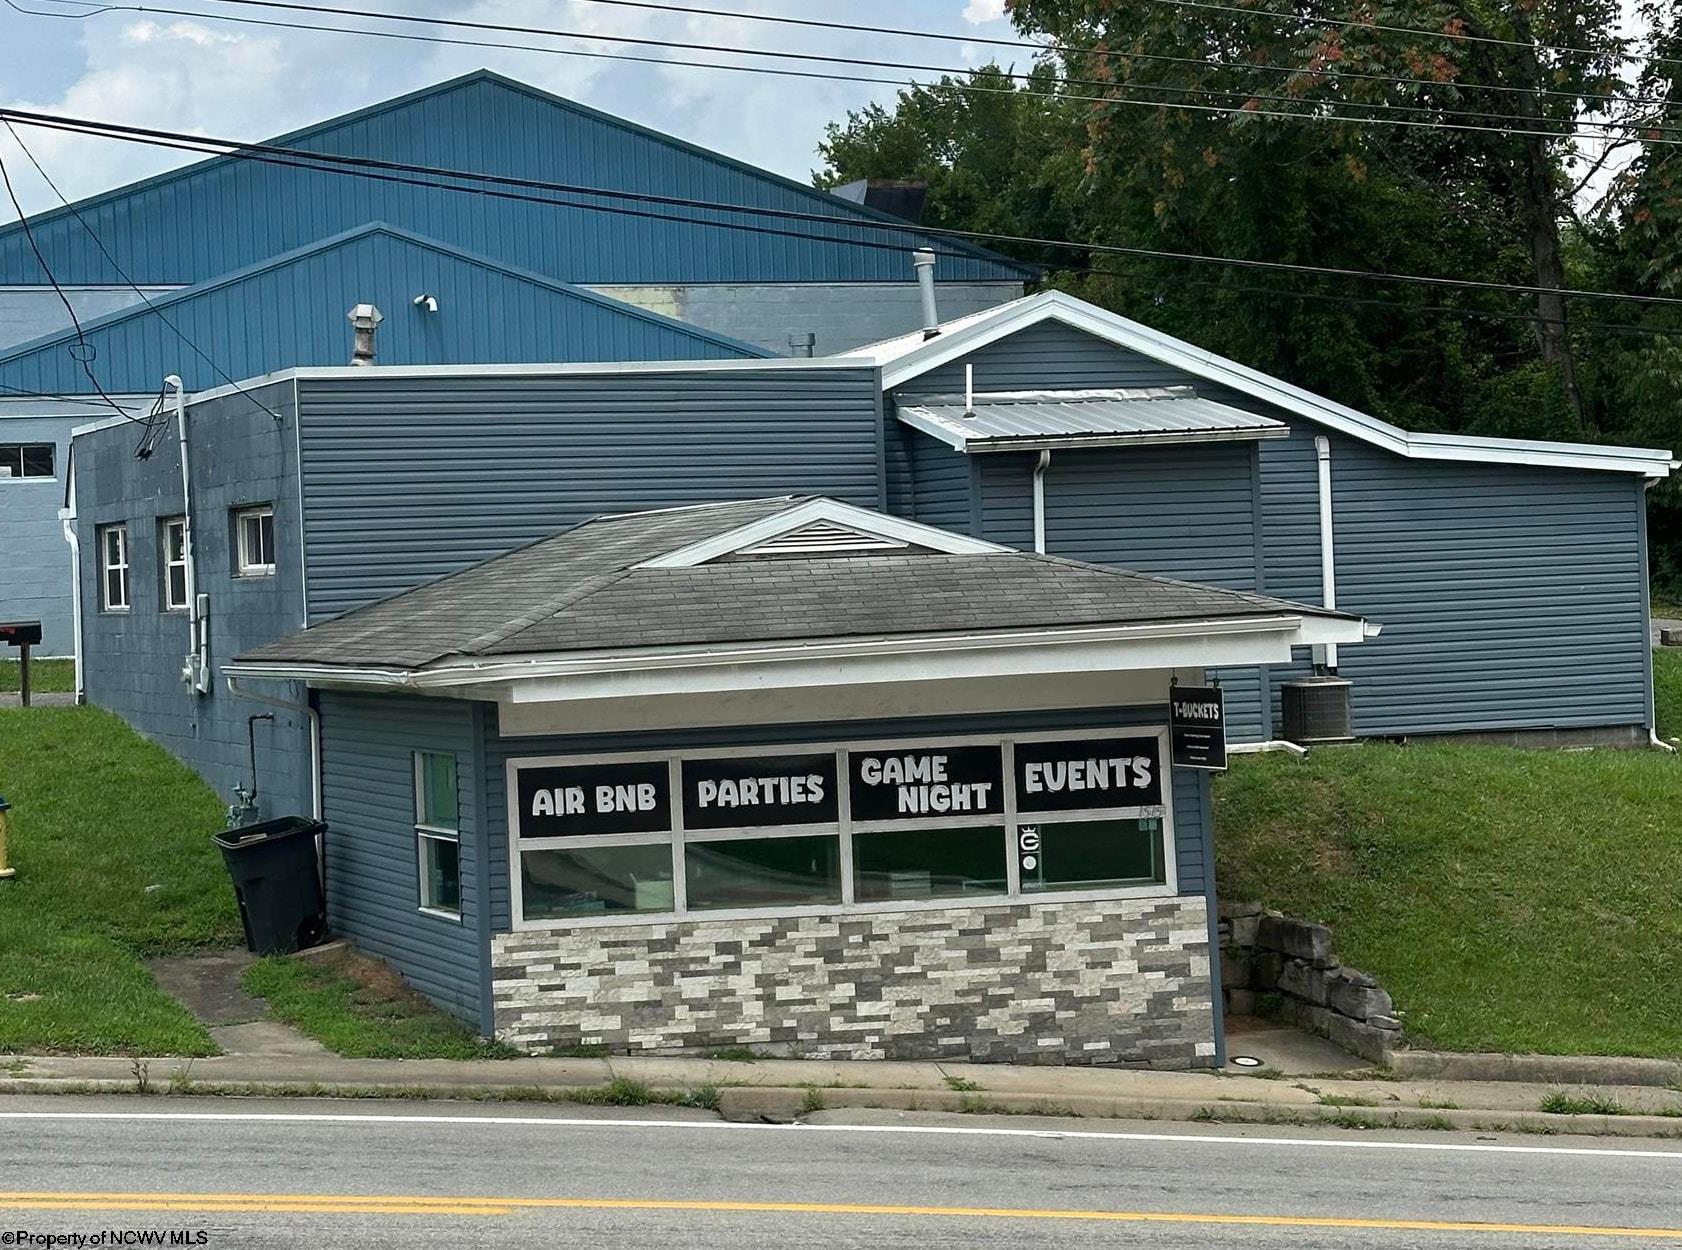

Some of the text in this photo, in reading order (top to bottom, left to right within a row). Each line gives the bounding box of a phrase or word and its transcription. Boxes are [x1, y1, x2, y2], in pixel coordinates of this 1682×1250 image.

[1173, 702, 1219, 720] T-BUCKETS
[860, 755, 949, 786] GAME
[1025, 756, 1153, 795] EVENTS
[532, 783, 657, 817] AIR BNB
[697, 775, 825, 809] PARTIES
[897, 782, 993, 814] NIGHT
